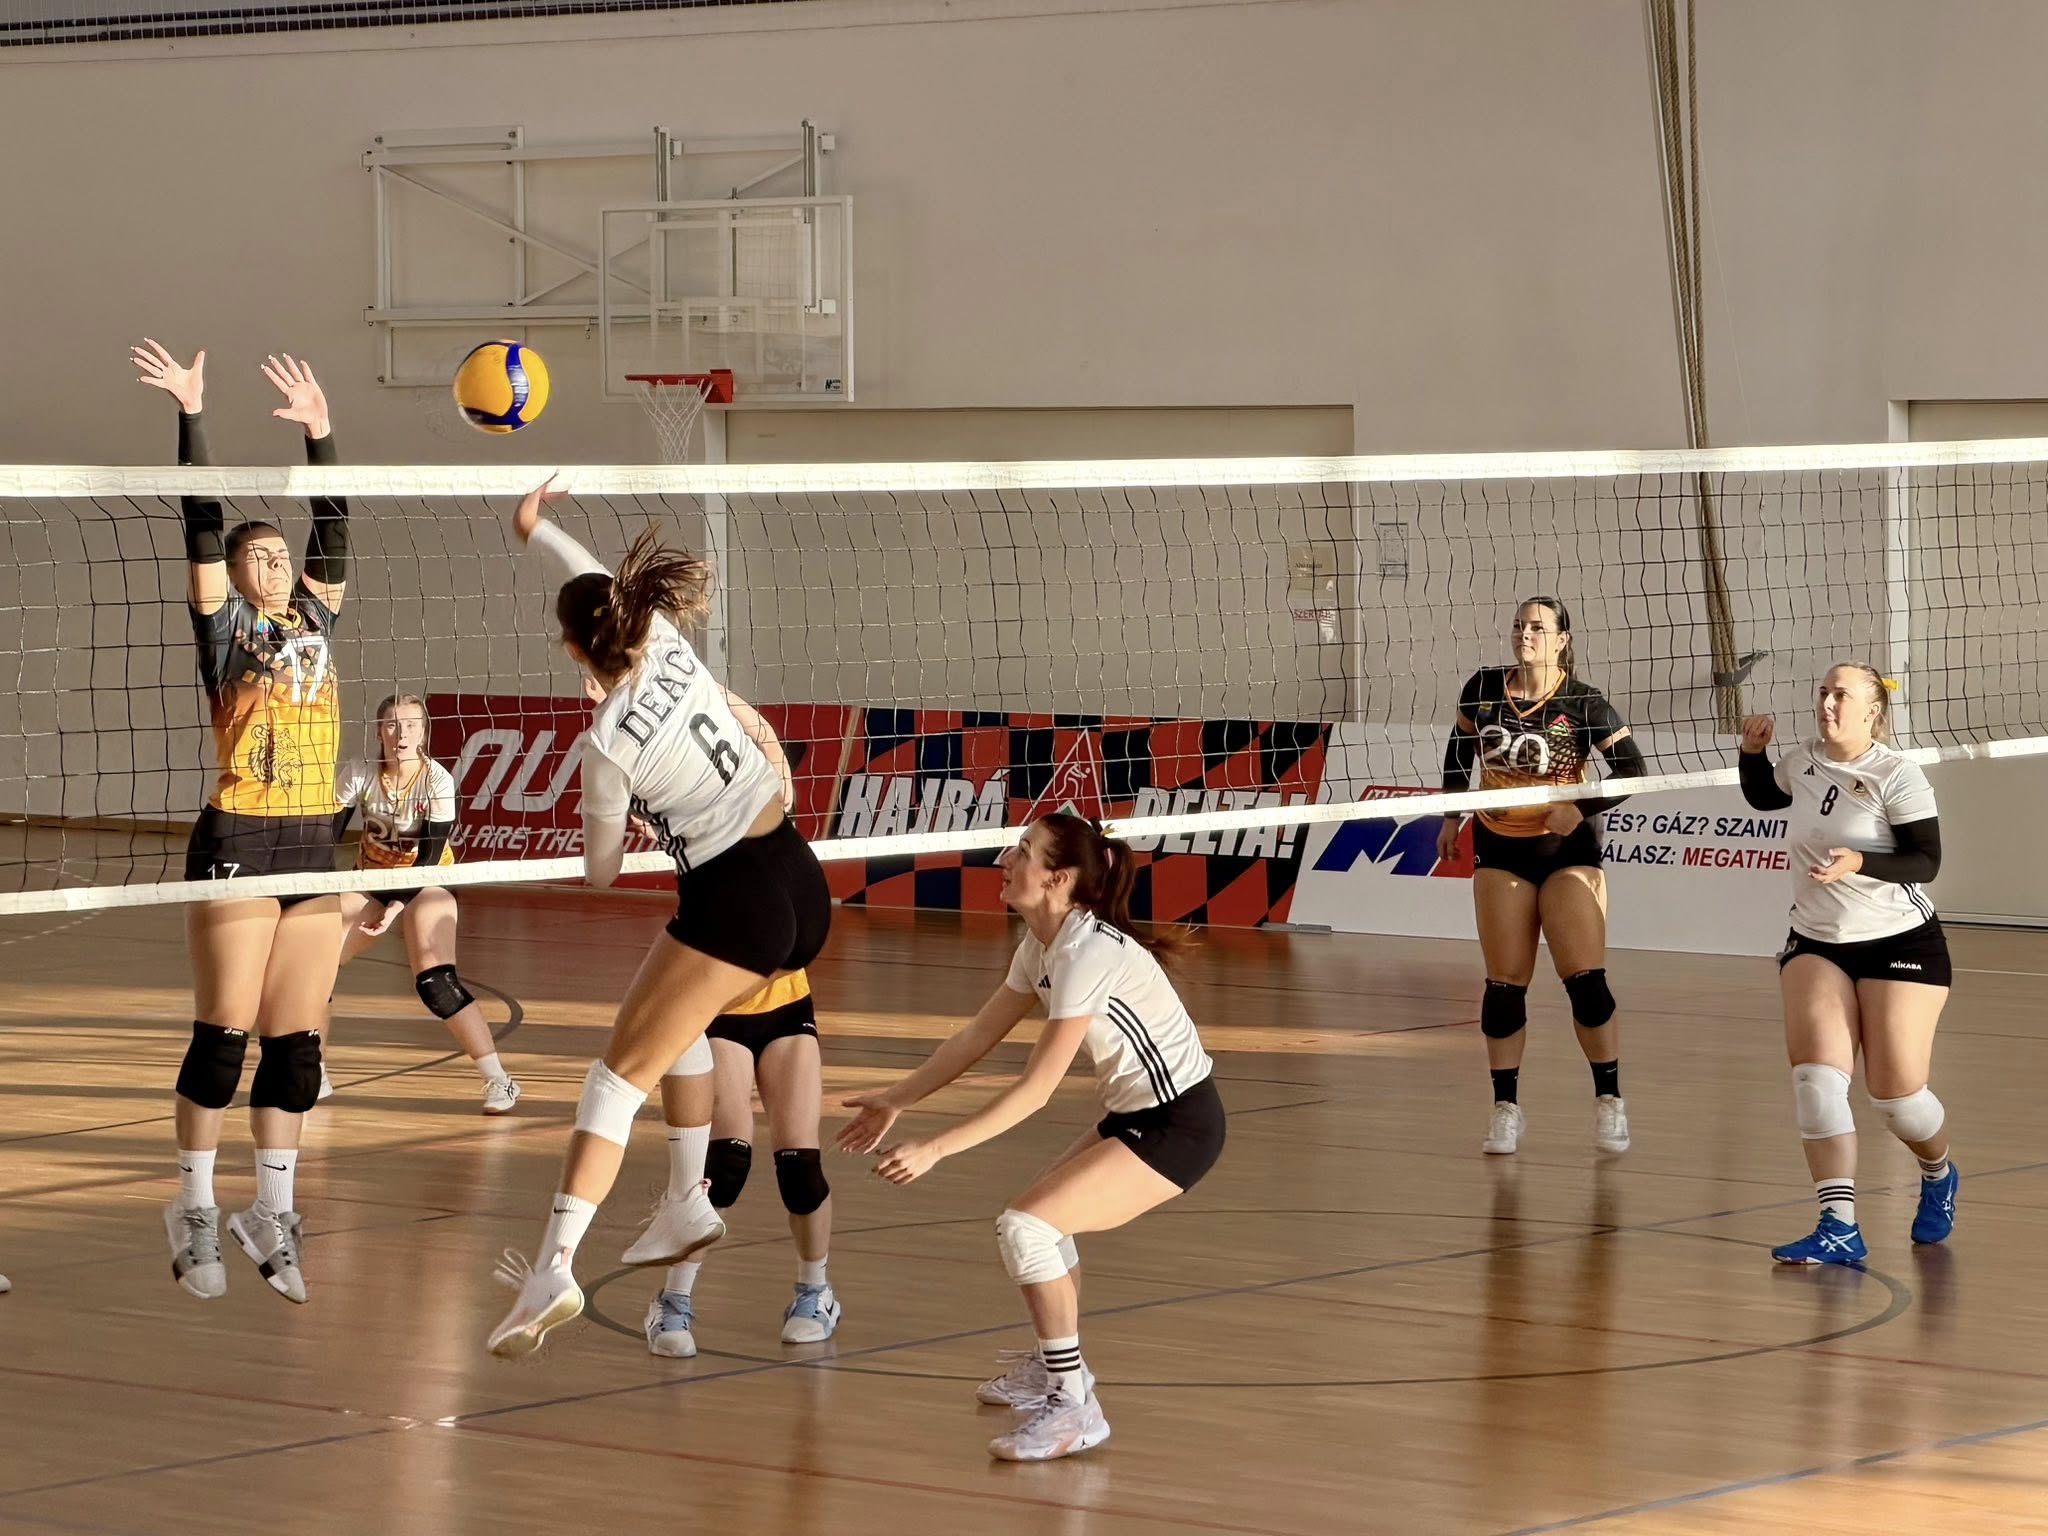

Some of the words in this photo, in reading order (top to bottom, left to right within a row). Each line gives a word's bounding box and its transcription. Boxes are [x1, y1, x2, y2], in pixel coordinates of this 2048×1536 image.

[275, 635, 330, 703] 17
[616, 650, 697, 749] DEAC
[689, 713, 740, 786] 6
[1480, 724, 1549, 776] 20
[837, 769, 1011, 837] HAJRÁ
[1127, 787, 1307, 859] DELTA!
[1820, 785, 1839, 816] 8
[471, 825, 532, 849] ARE
[535, 827, 584, 852] THE
[1653, 811, 1709, 835] GÁZ?
[207, 863, 240, 880] 17
[1600, 839, 1676, 865] ÁLASZ:
[1682, 847, 1790, 870] MEGATHE
